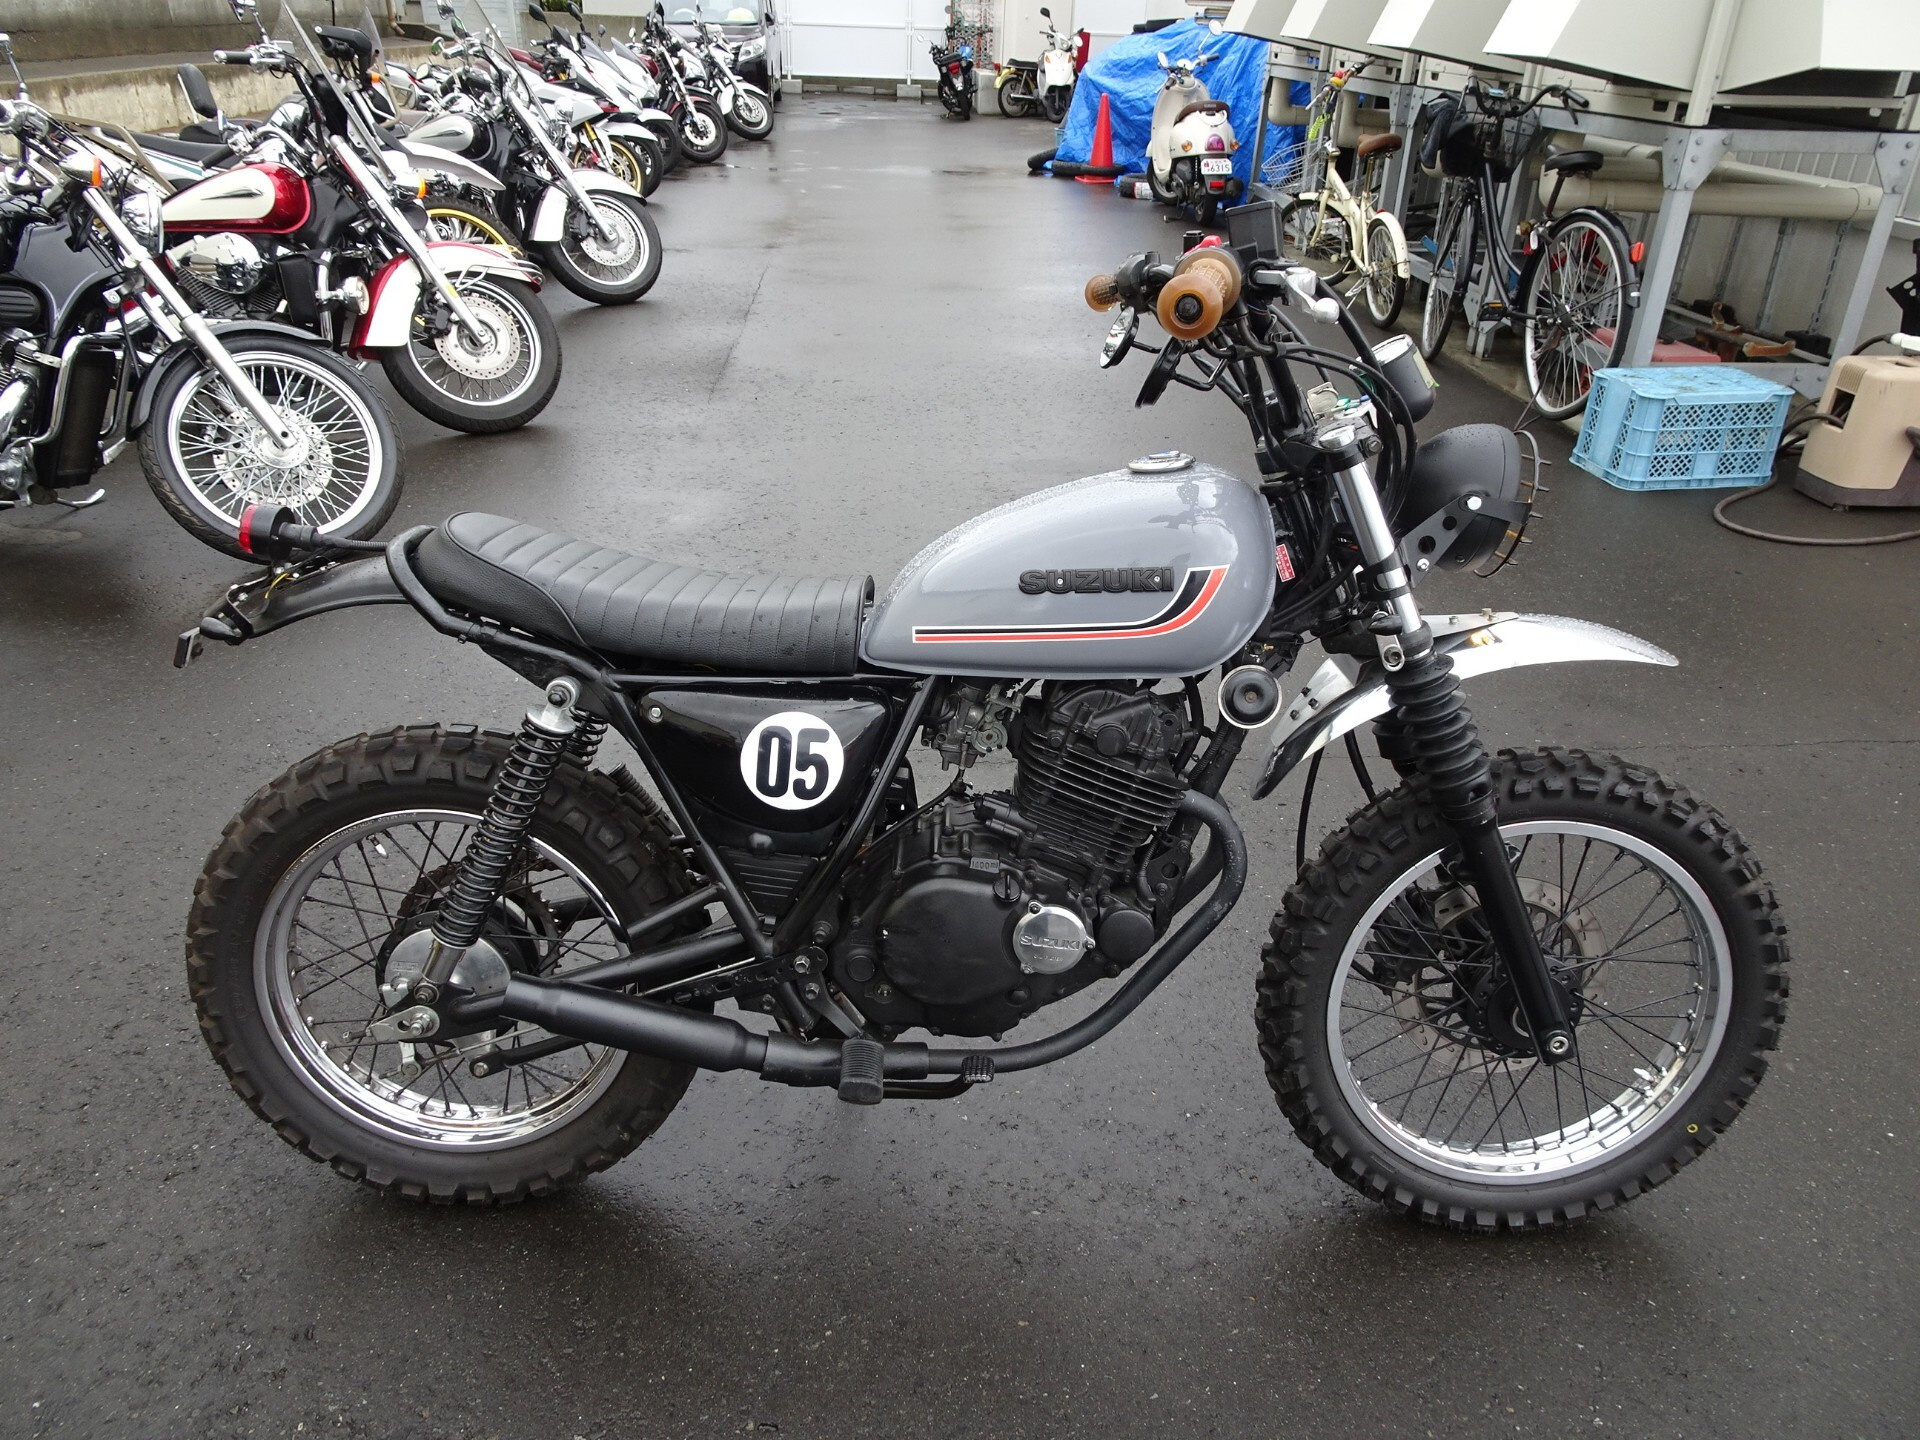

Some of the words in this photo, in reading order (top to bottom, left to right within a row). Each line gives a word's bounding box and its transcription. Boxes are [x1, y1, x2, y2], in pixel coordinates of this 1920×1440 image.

[1019, 567, 1174, 594] SUZUKI
[756, 725, 830, 801] 05
[1020, 934, 1080, 951] SUZUKI
